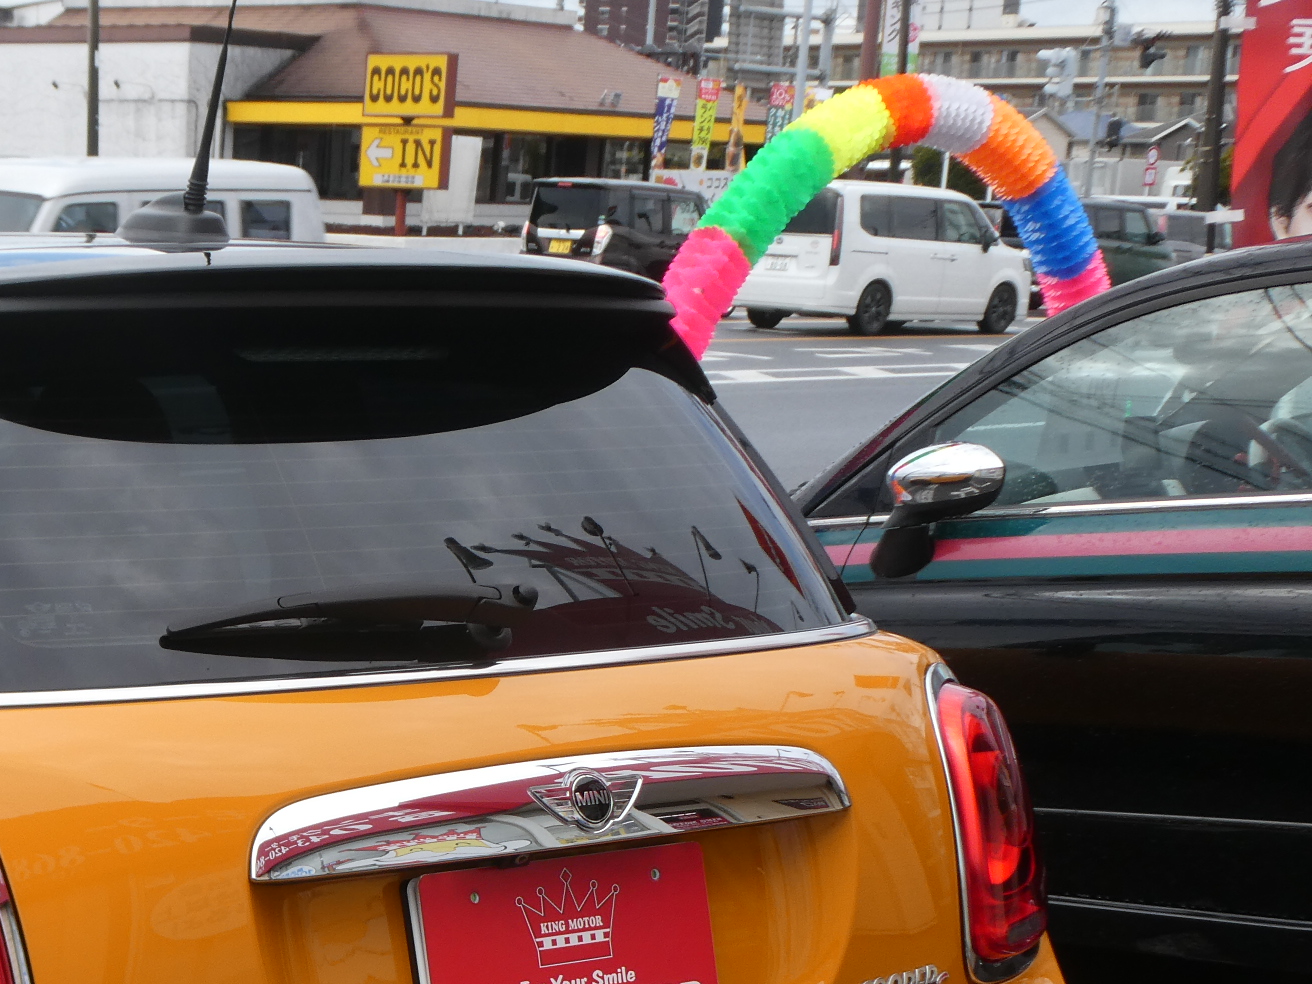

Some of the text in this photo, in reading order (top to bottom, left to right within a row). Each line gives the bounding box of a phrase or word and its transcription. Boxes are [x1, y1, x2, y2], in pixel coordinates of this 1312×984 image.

[369, 63, 443, 104] COCO'S
[399, 138, 437, 169] IN
[575, 789, 609, 807] MINI
[540, 915, 603, 935] KING MOTOR
